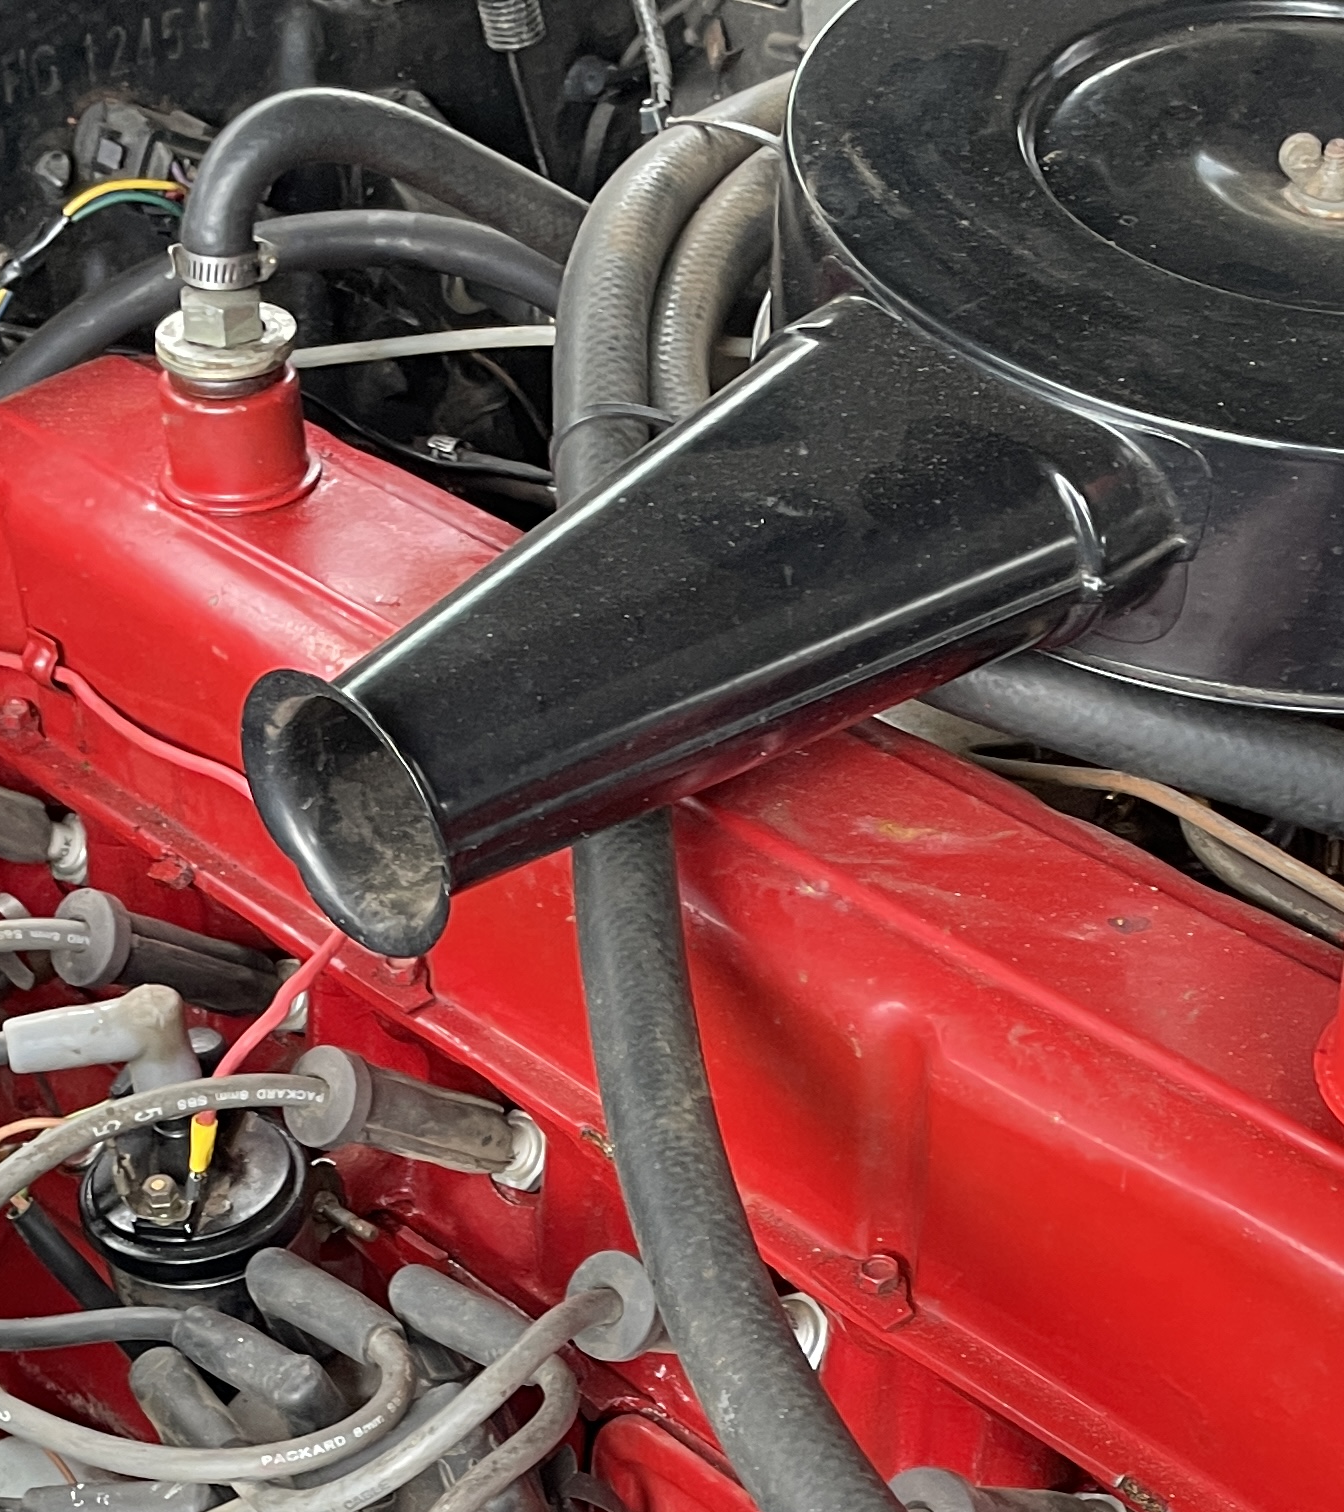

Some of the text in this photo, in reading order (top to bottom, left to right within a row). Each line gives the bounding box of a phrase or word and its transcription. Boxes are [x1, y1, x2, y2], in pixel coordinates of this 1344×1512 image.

[256, 1087, 325, 1103] PACKARD
[133, 1107, 164, 1123] 5
[92, 1120, 122, 1138] 5
[260, 1435, 347, 1467] PACKARD
[352, 1414, 385, 1439] 8mm
